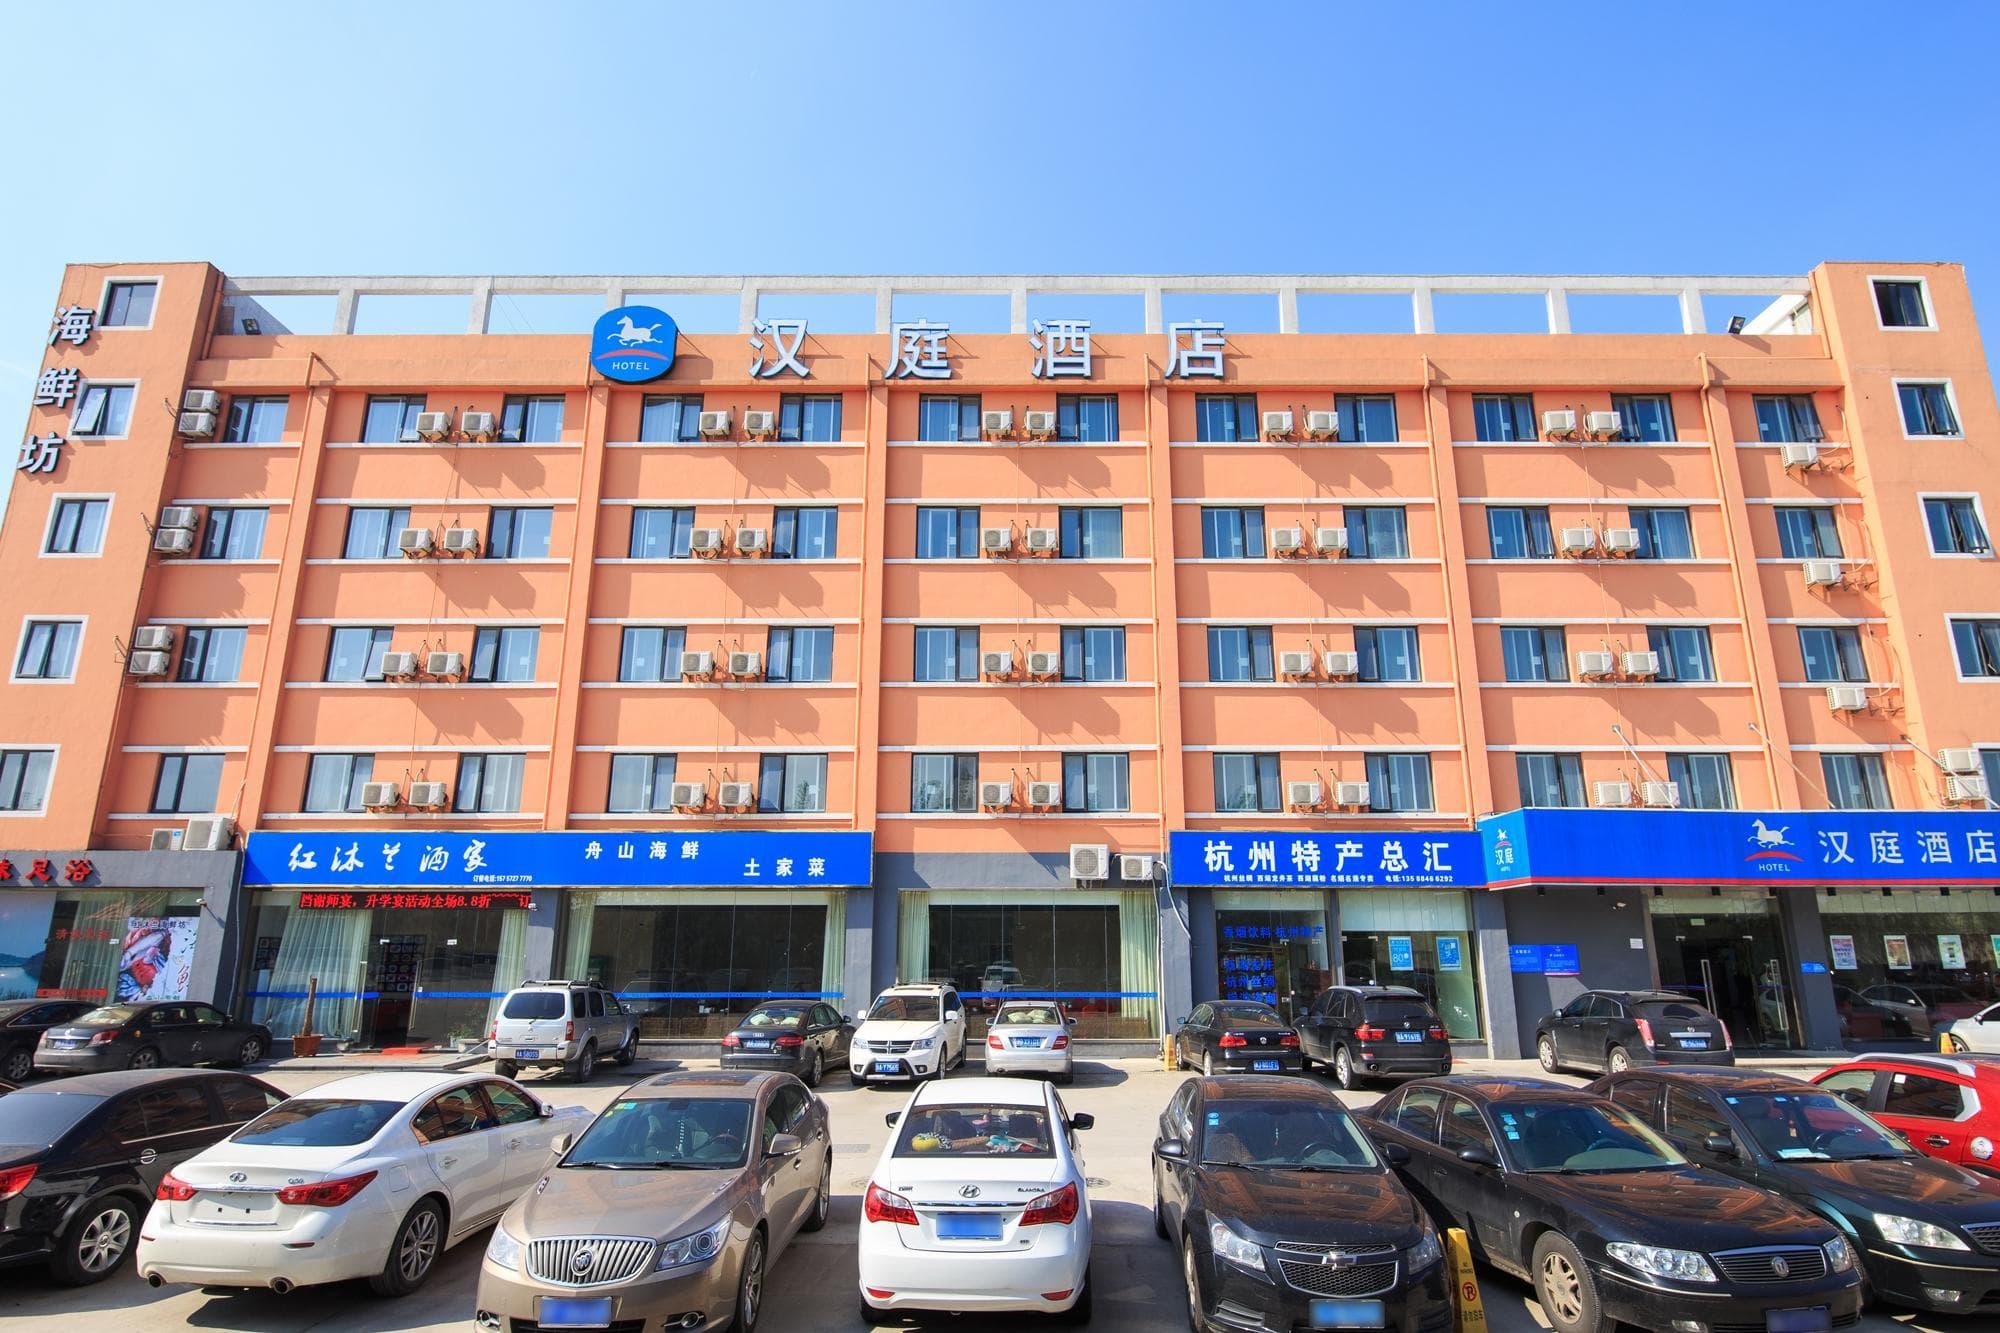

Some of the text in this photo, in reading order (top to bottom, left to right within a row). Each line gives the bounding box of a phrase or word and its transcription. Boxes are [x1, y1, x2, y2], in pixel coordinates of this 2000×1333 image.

[748, 317, 1226, 379] 汉庭酒店
[612, 361, 650, 371] HOTEL
[17, 305, 95, 473] 海鲜坊
[584, 840, 700, 860] 舟山海鲜
[1203, 839, 1453, 872] 杭州特产总汇
[1494, 847, 1515, 865] 汉庭
[1816, 829, 1998, 864] 汉庭酒店
[743, 857, 826, 877] 土家菜
[1758, 863, 1791, 872] HOTEL
